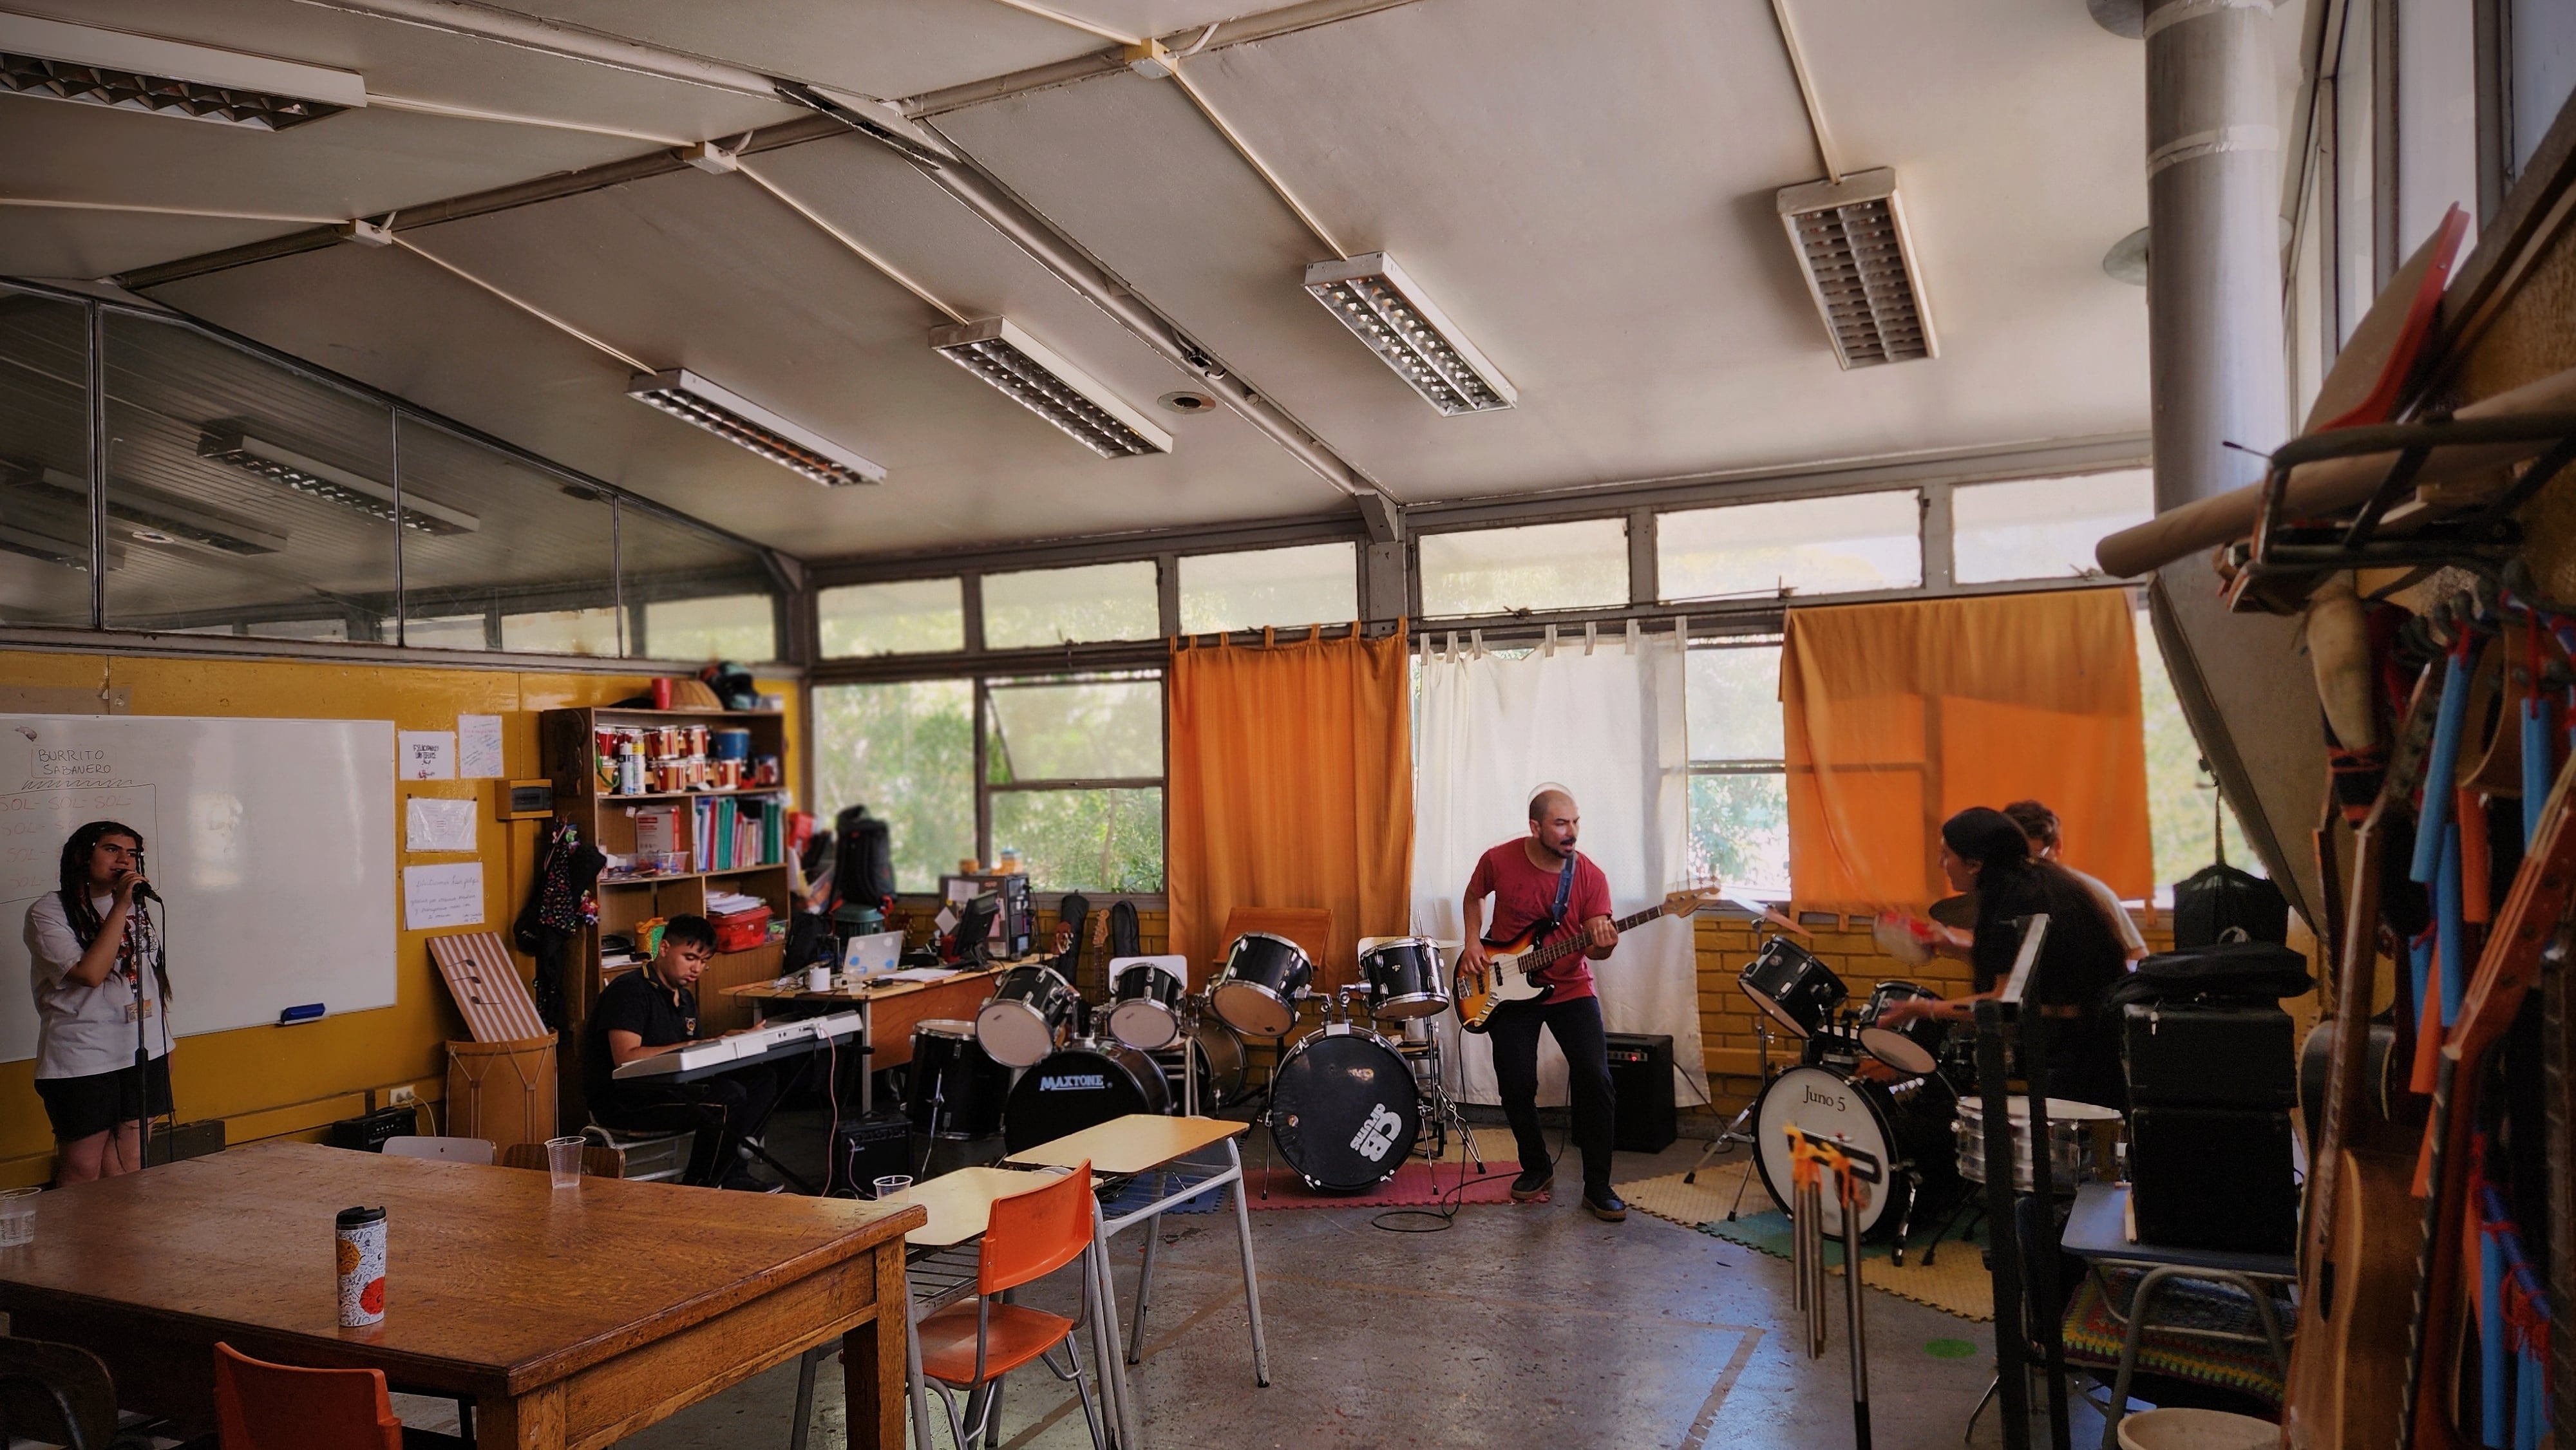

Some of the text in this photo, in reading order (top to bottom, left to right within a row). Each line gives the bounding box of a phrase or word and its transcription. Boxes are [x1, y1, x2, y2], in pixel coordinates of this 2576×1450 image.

[38, 749, 104, 762] BURRITO
[43, 764, 111, 775] SABANERO
[1039, 1075, 1104, 1091] MAXTONE
[1803, 1085, 1846, 1112] Juno 5
[1359, 1111, 1402, 1162] CB
